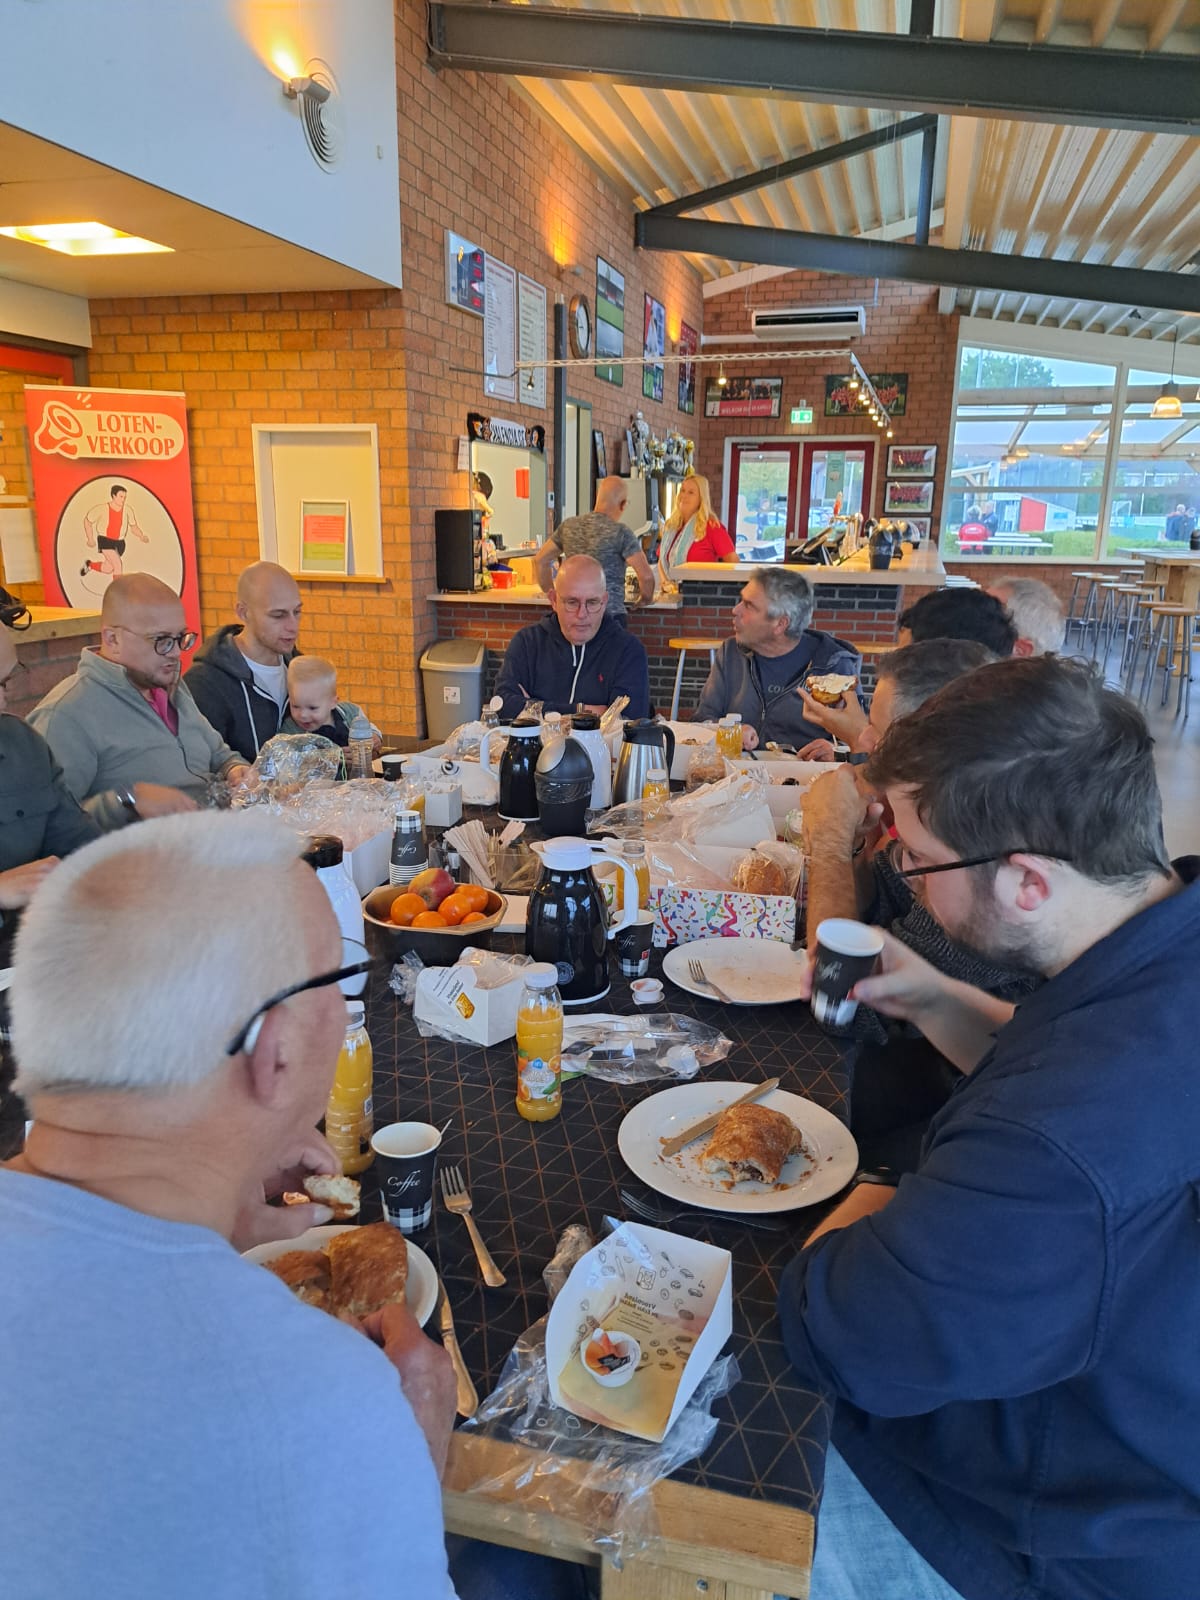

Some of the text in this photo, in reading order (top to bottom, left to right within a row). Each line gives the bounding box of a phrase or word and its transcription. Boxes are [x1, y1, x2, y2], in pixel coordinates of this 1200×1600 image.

[96, 413, 162, 434] LOTEN-
[86, 434, 175, 456] VERKOOP
[387, 1169, 421, 1197] Coffee
